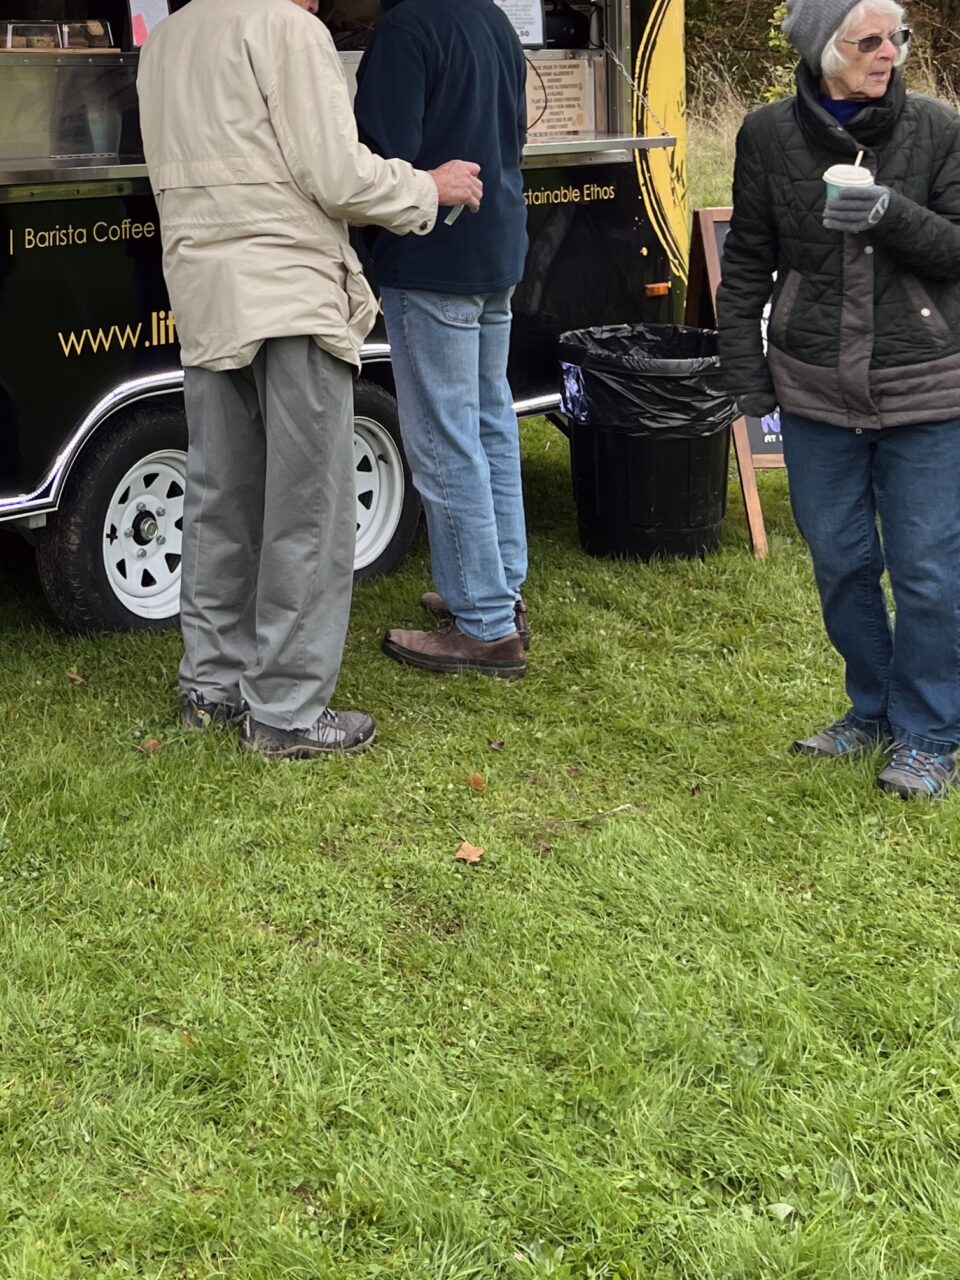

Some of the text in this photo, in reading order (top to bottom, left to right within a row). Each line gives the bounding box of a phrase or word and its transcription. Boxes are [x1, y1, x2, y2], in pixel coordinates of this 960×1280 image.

[583, 184, 615, 201] Ethos
[25, 224, 87, 249] Barista
[93, 219, 155, 242] Coffee
